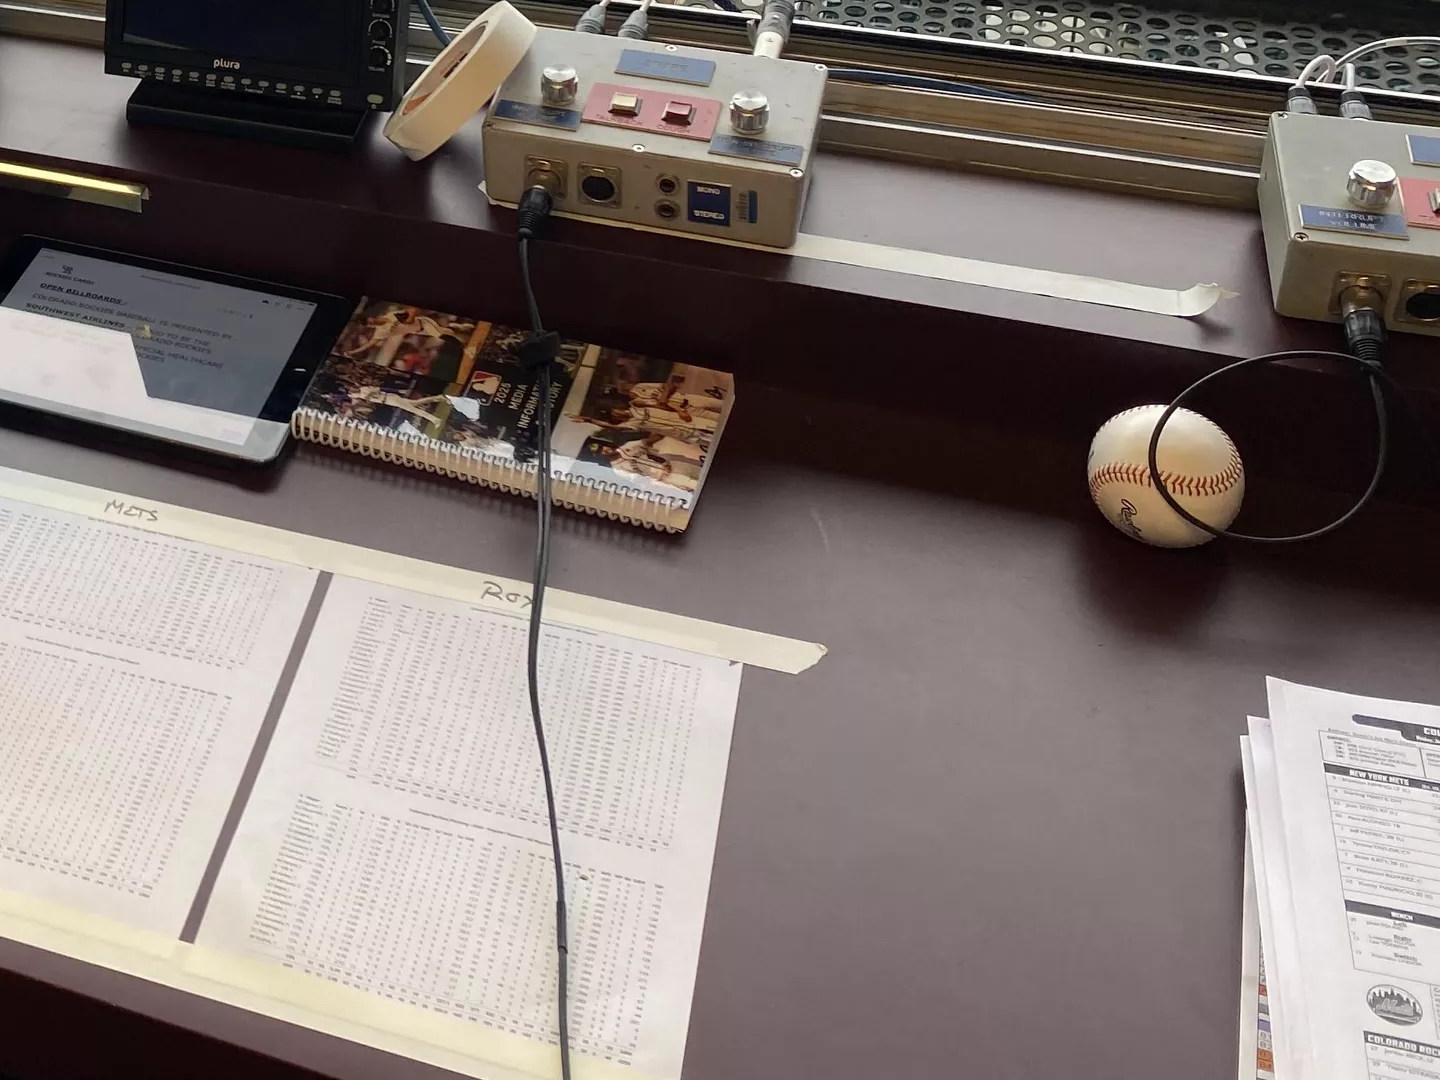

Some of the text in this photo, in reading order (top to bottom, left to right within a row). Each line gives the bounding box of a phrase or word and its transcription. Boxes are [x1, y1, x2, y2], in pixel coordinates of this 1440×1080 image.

[213, 58, 241, 70] plura
[656, 123, 691, 135] COUGH
[696, 185, 721, 195] MONO
[692, 209, 725, 220] STEREO
[32, 292, 78, 308] COLORADO
[39, 282, 123, 306] OPEN BILLBOARDS
[25, 302, 80, 318] SOUTHWEST
[81, 314, 126, 329] AIRLINES
[507, 384, 528, 411] MEDIA
[516, 382, 540, 429] INFORMAT
[104, 498, 159, 522] METS
[1348, 769, 1410, 786] NEW YORK METS
[1367, 1033, 1417, 1052] COLORADO
